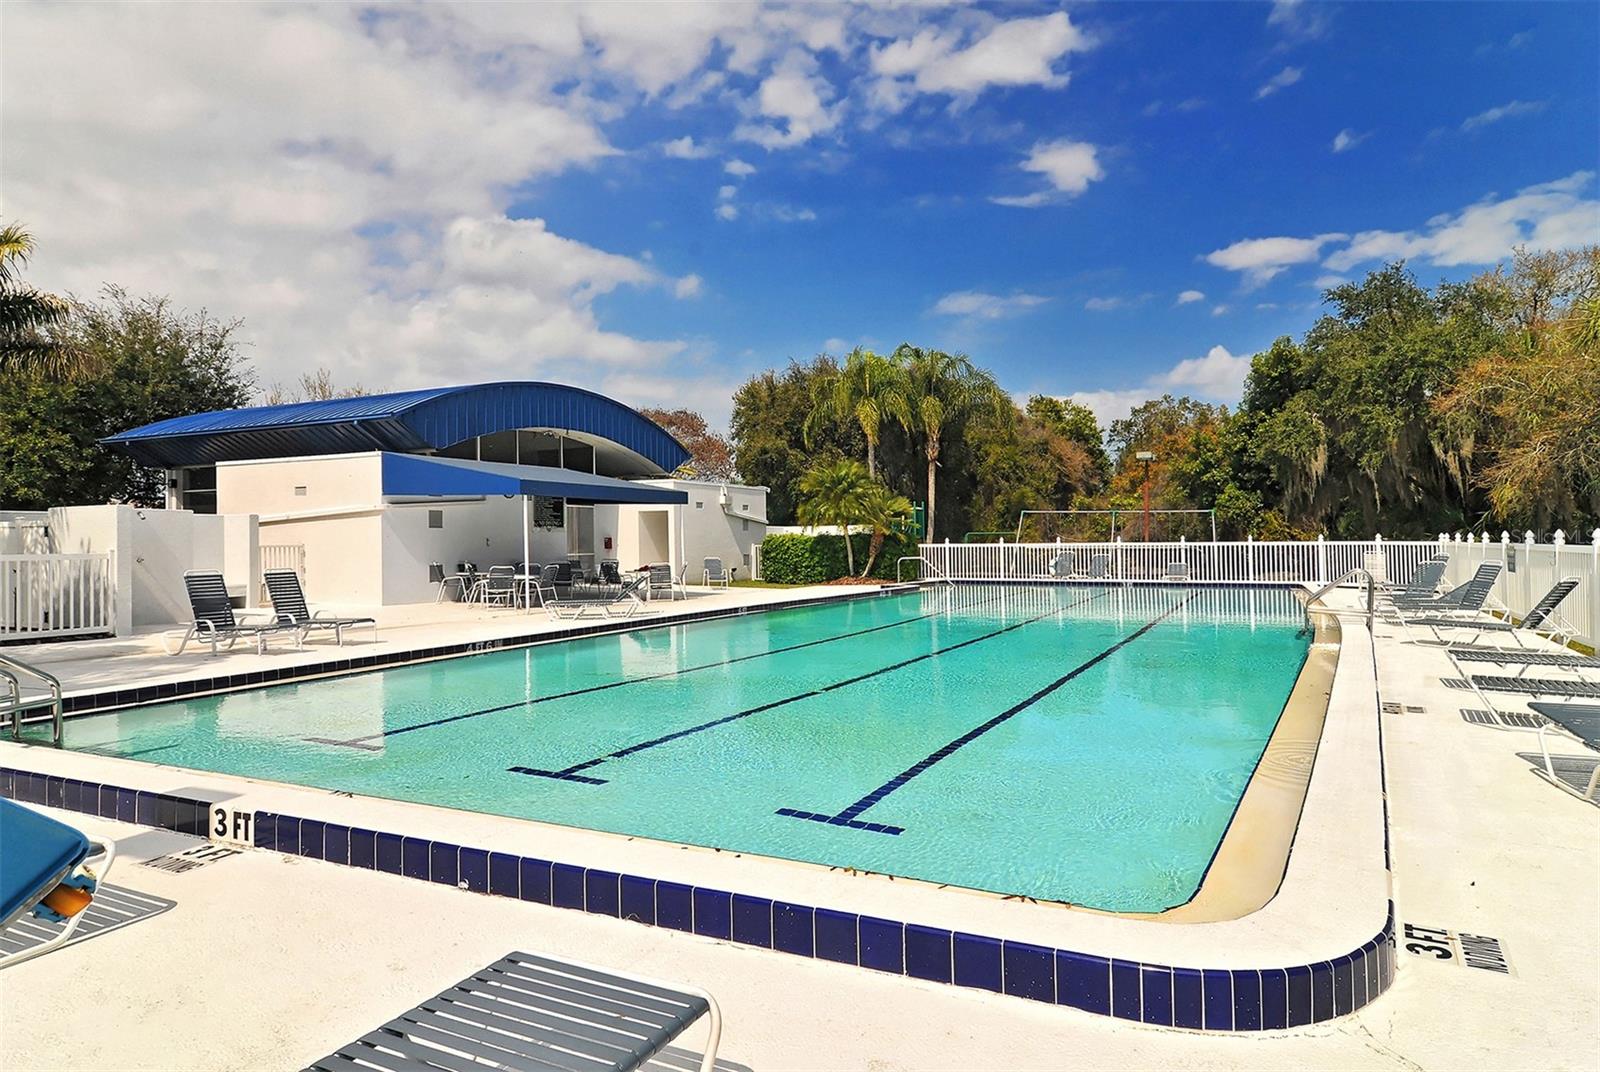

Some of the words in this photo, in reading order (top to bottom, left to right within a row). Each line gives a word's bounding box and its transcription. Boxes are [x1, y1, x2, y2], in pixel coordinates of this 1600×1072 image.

[214, 808, 228, 837] 3
[233, 811, 251, 841] FT
[183, 845, 214, 856] 3
[1405, 943, 1453, 959] 3
